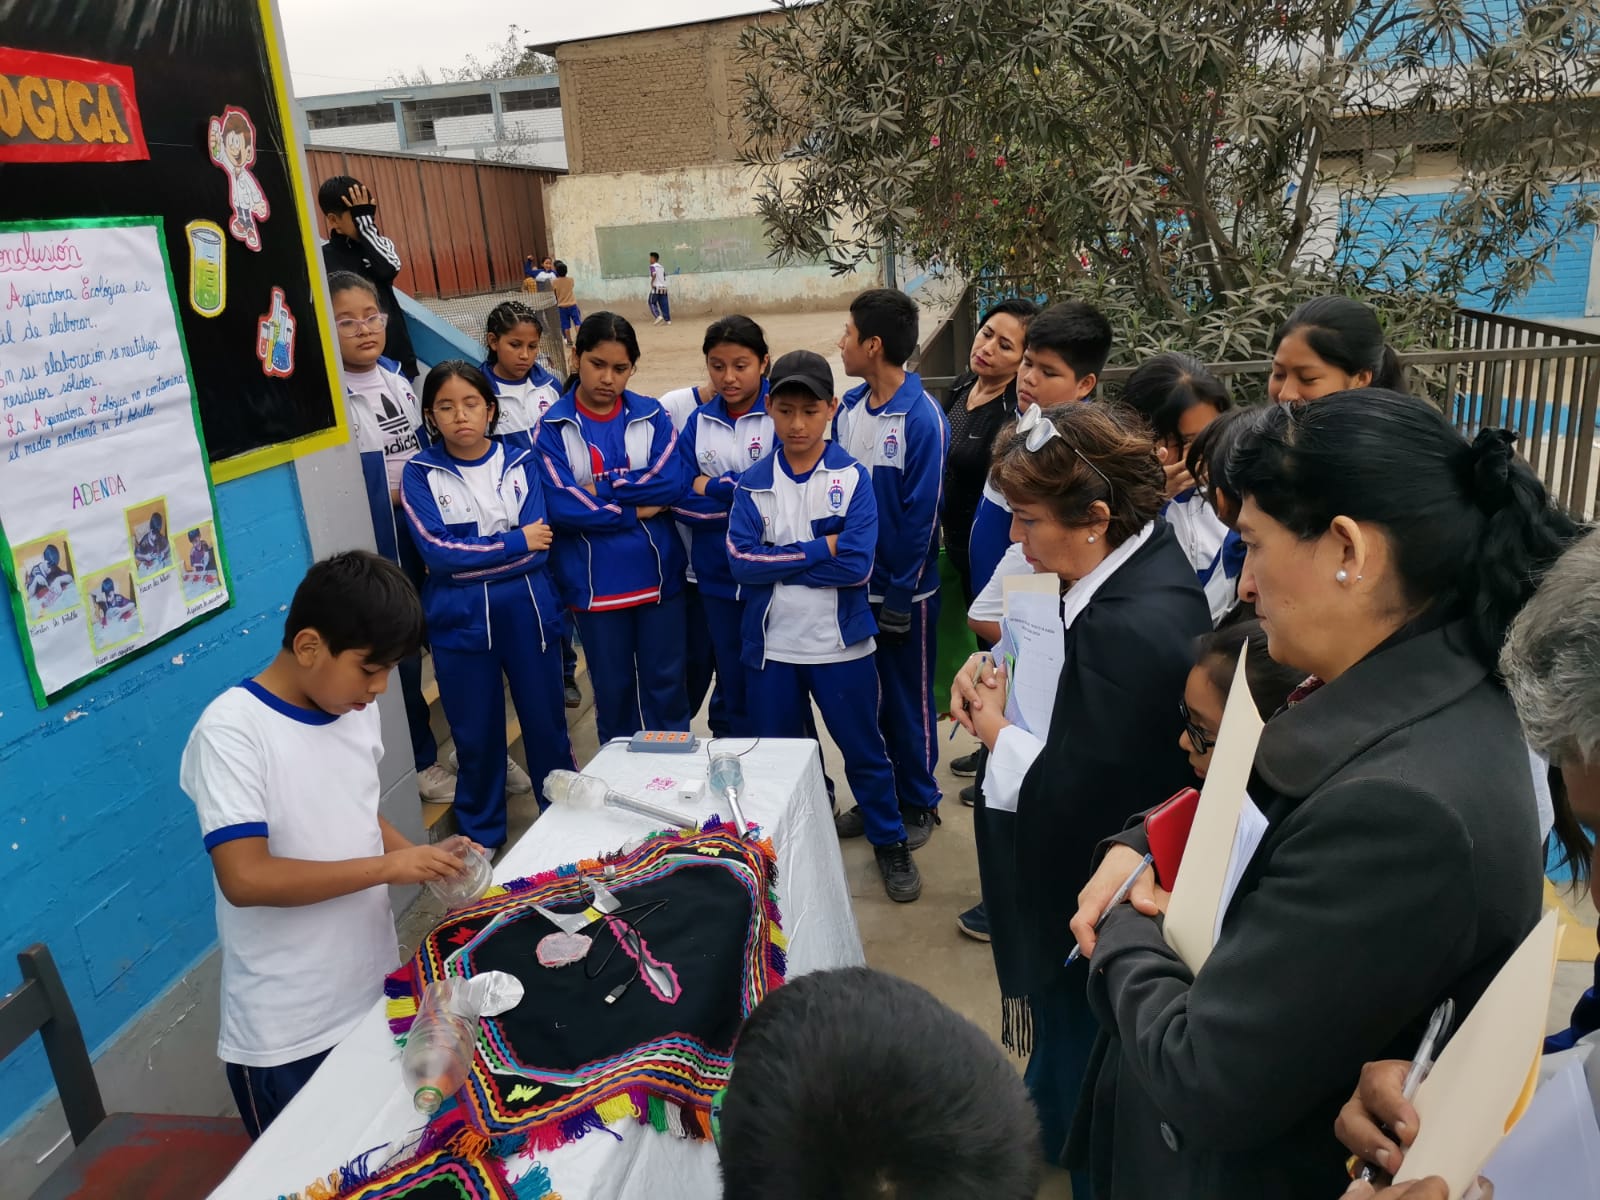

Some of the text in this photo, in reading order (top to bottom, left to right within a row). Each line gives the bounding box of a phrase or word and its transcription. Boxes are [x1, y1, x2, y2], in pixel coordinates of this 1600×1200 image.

[6, 274, 151, 315] Aspiradora Ecológica es
[22, 319, 42, 342] de
[19, 366, 38, 383] su
[44, 343, 107, 376] elaboración
[109, 347, 119, 361] se
[3, 385, 54, 410] residuos
[5, 414, 26, 438] La
[33, 402, 87, 432] Aspiradora
[131, 390, 141, 401] no
[145, 375, 185, 397] contamina
[8, 440, 20, 462] el
[24, 435, 52, 456] medio
[57, 420, 98, 447] ambiente
[102, 420, 110, 431] ni
[72, 474, 126, 509] ADENDA
